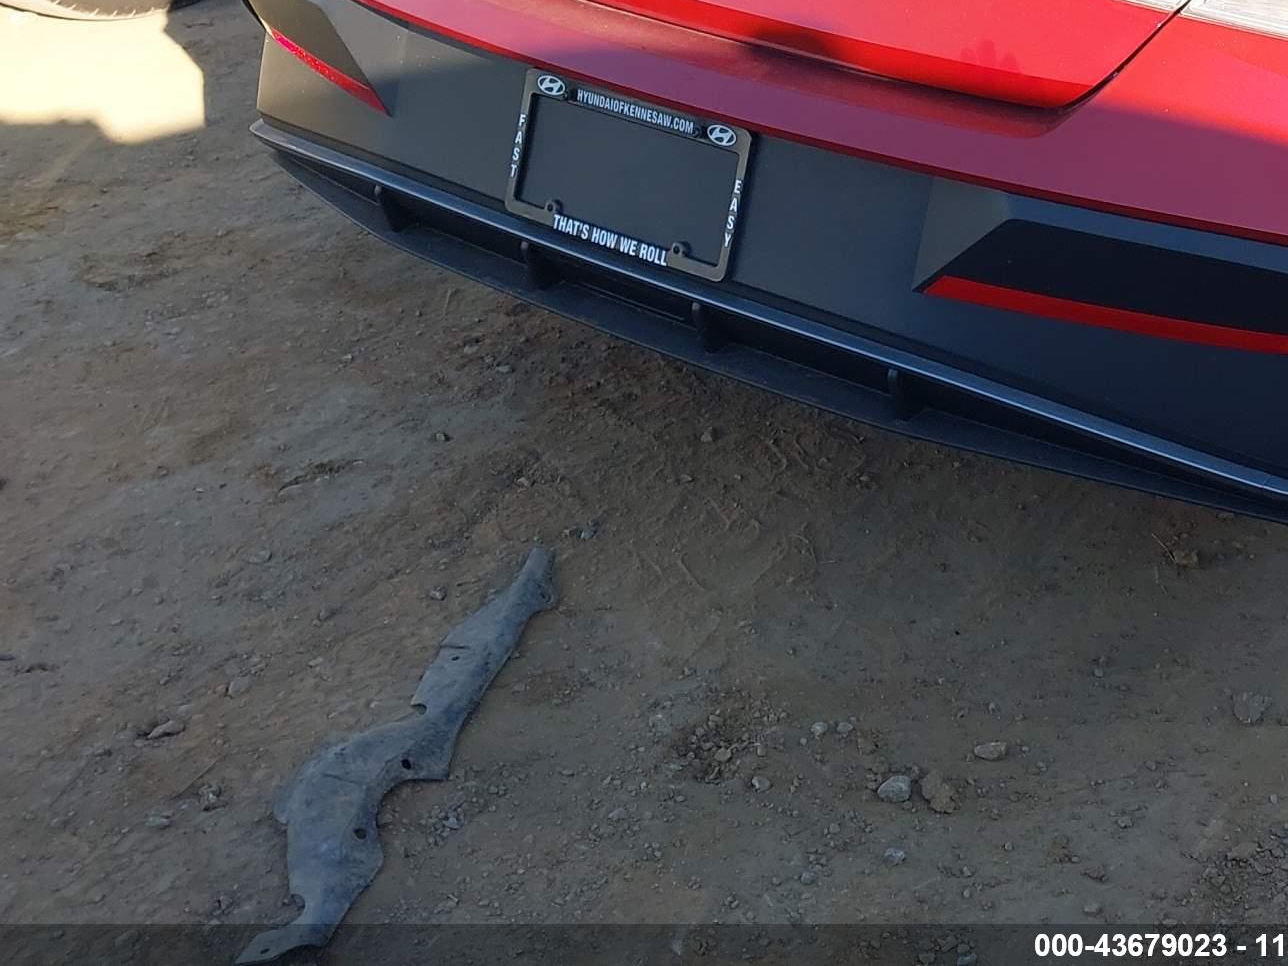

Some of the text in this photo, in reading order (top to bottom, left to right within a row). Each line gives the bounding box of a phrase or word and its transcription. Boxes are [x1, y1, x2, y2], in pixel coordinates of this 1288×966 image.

[577, 89, 694, 134] HYUNDAIOFKENNESAW.COM
[510, 113, 526, 178] FAST
[552, 214, 667, 266] THAT'S HOW WE ROLL
[724, 179, 742, 247] EASY
